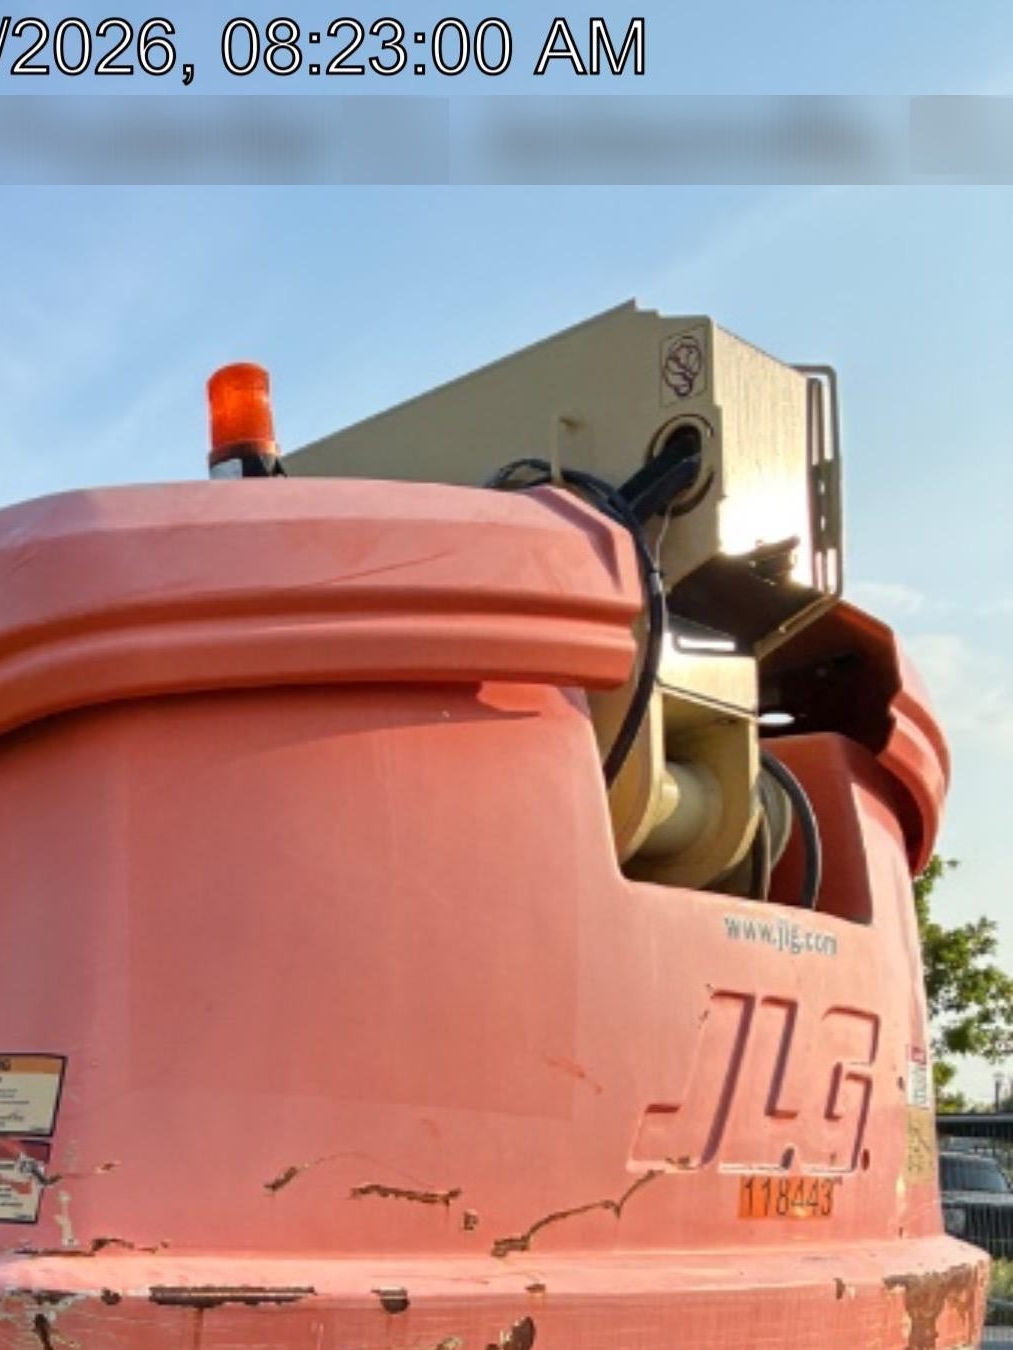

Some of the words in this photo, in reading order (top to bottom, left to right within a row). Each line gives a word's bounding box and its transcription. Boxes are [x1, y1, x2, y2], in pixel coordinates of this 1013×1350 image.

[724, 916, 837, 955] www.jlg.com
[630, 987, 881, 1173] JLG
[743, 1176, 835, 1217] 118443
